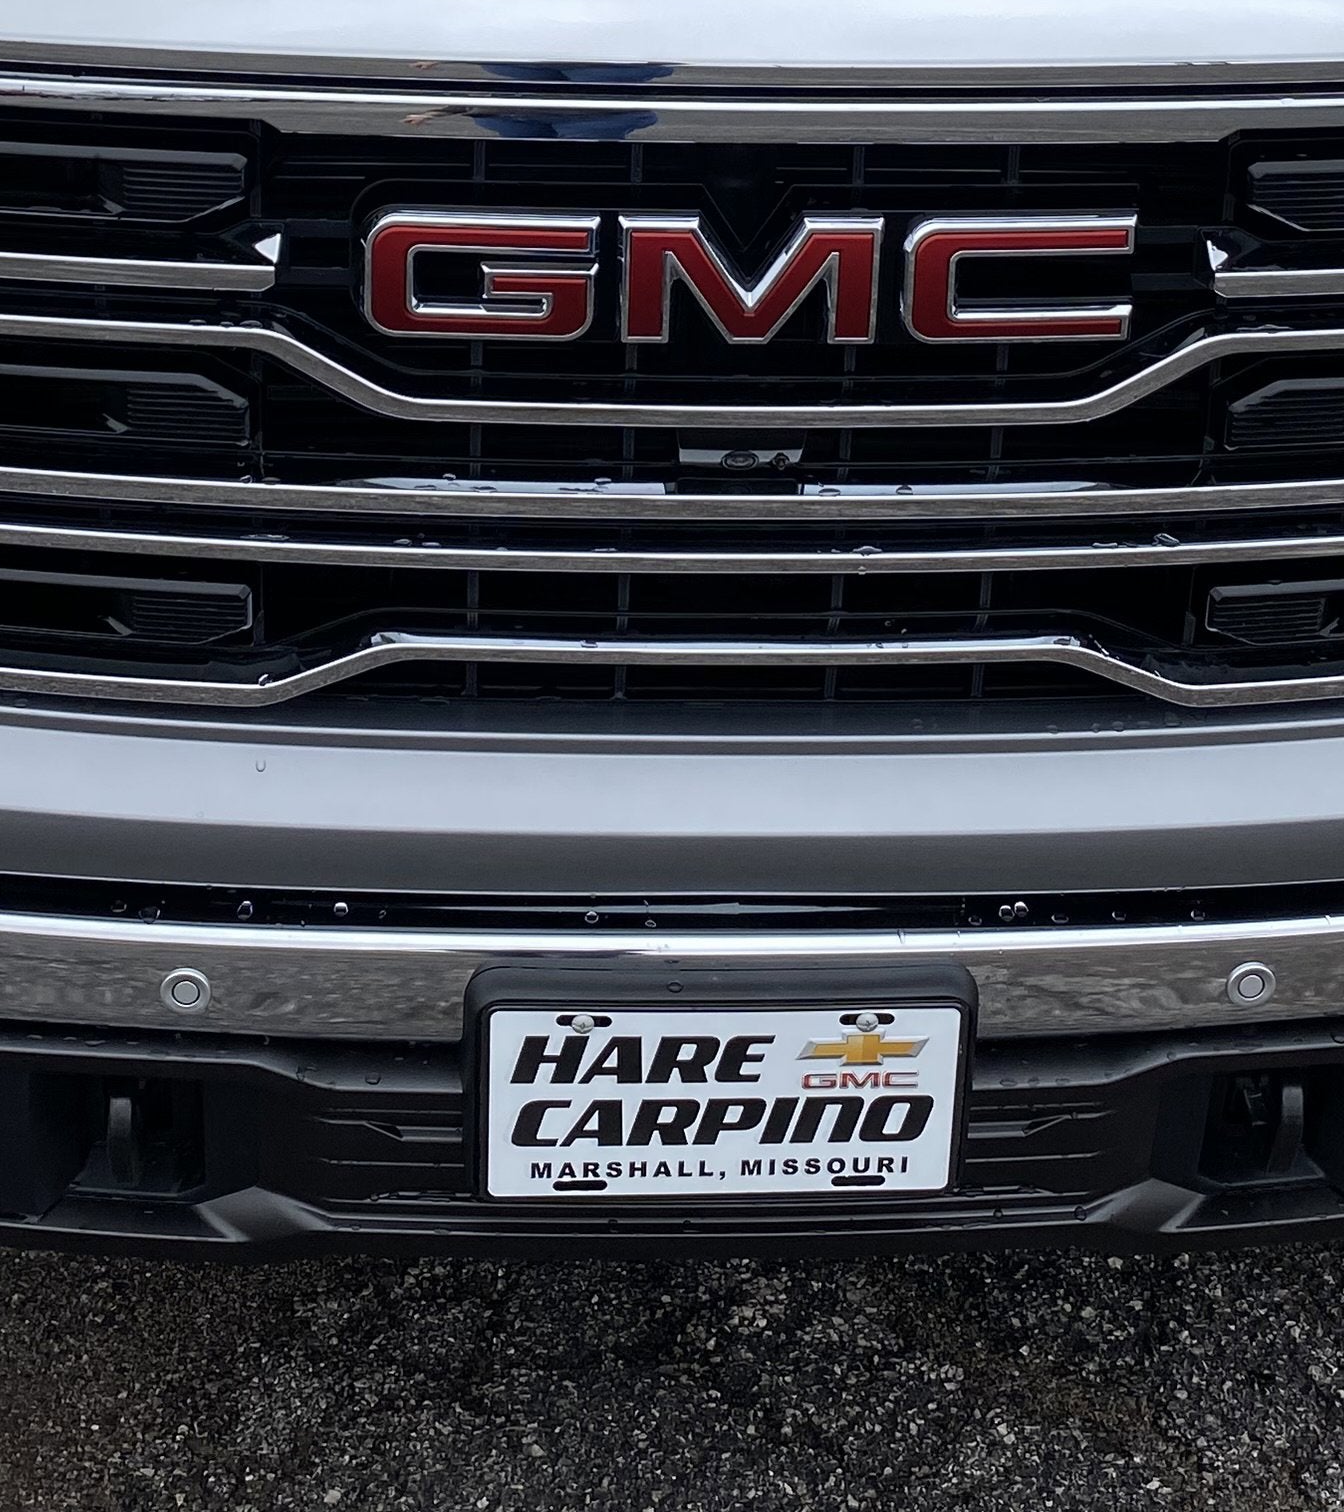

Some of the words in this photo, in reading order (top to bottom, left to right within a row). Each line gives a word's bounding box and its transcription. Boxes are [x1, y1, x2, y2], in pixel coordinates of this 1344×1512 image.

[361, 210, 1139, 345] GMC
[509, 1033, 777, 1085] HARE
[801, 1069, 920, 1090] GMC
[510, 1094, 936, 1147] CARPINO
[530, 1159, 727, 1181] MARSHALL,
[740, 1156, 909, 1177] MISSOURI
